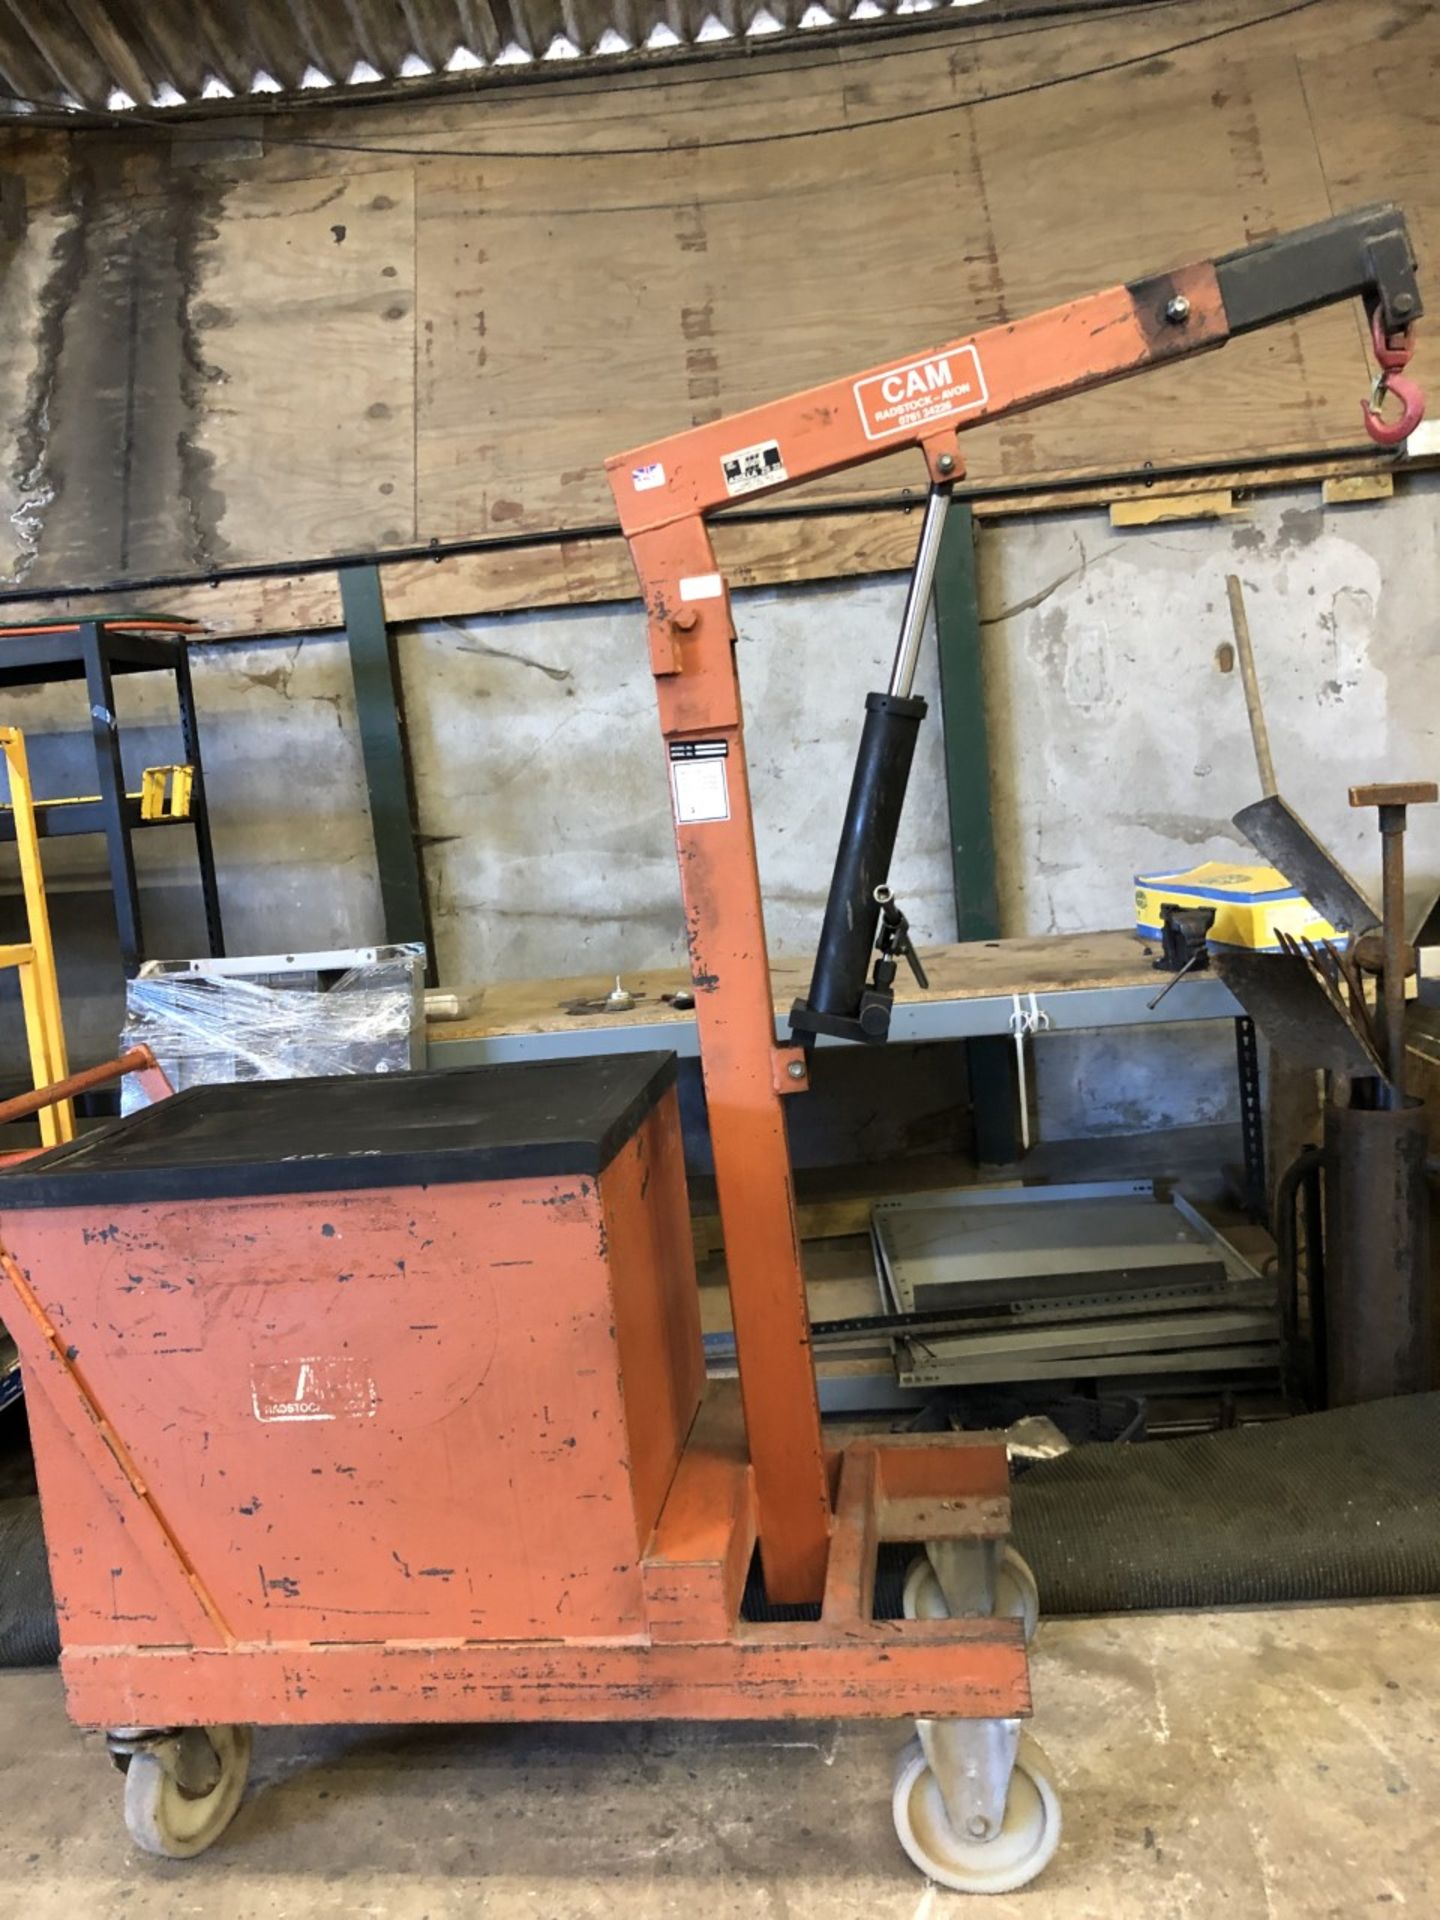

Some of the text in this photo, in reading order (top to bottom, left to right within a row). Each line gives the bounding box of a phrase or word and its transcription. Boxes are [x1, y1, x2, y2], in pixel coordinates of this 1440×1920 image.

[882, 359, 952, 403] CAM
[875, 396, 933, 422] RADSTOCK
[941, 383, 970, 401] AVON
